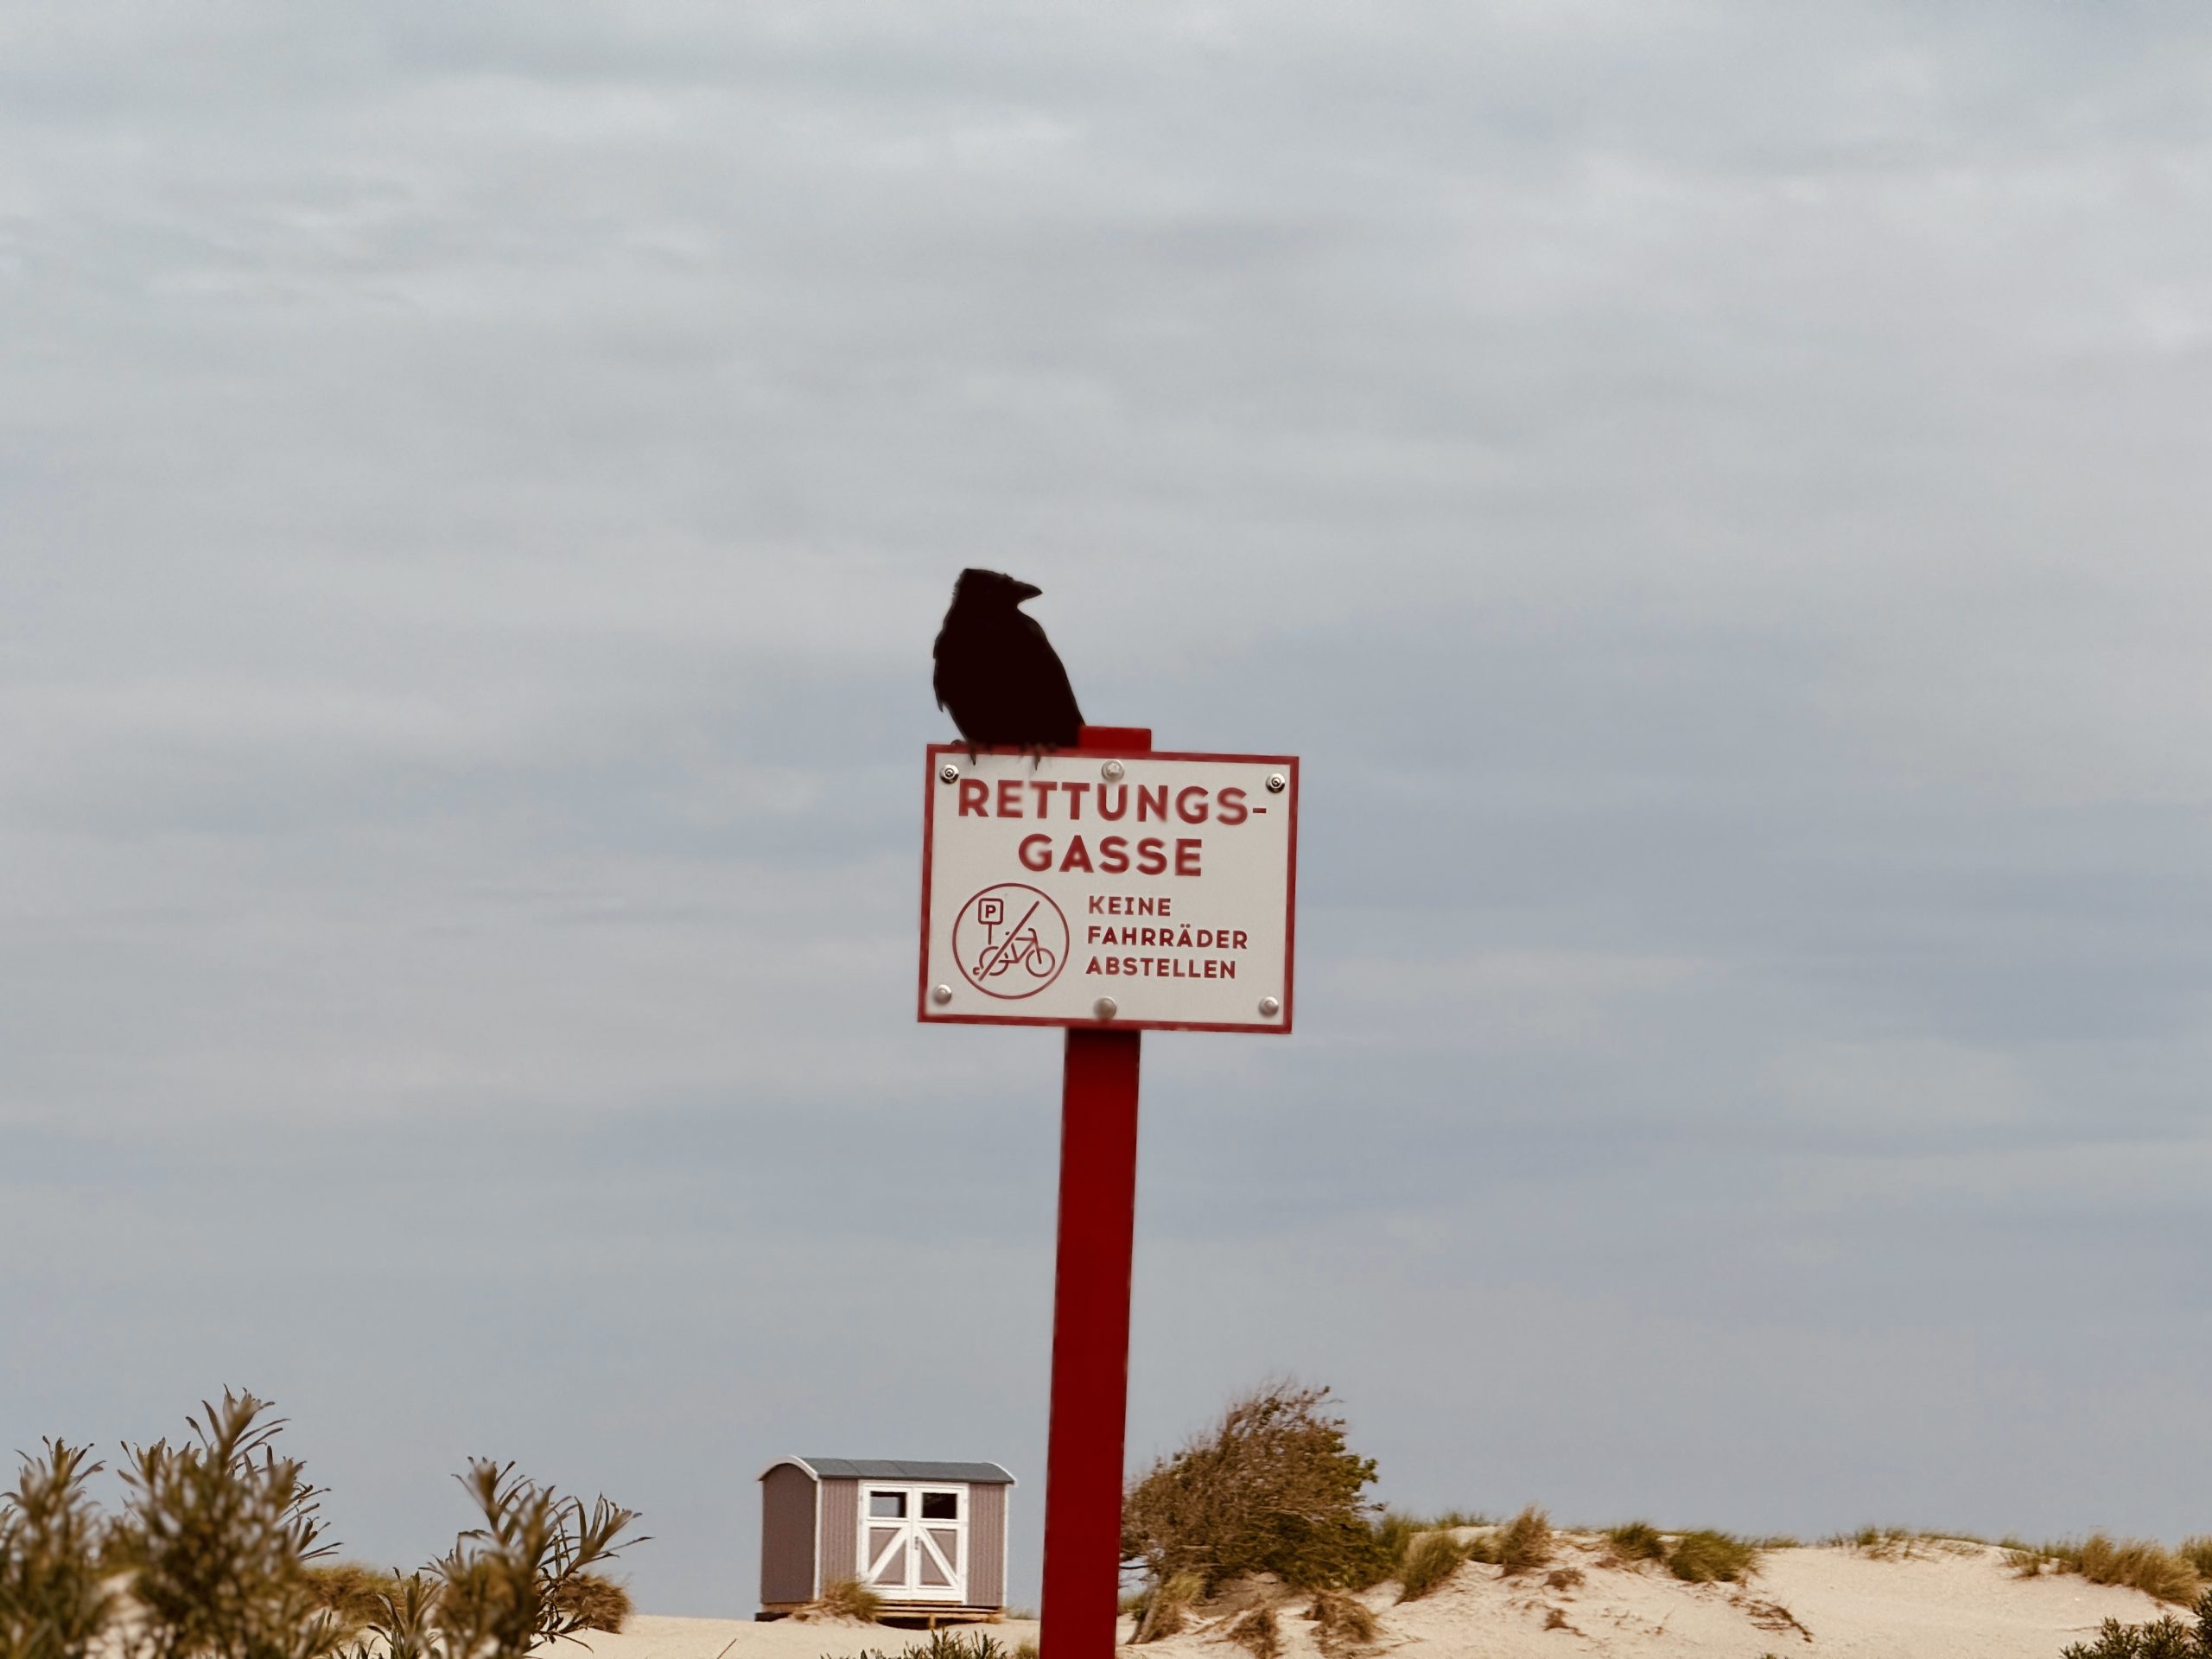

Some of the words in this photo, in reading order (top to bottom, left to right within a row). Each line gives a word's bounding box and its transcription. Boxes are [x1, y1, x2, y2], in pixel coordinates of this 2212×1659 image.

[957, 779, 1267, 825] RETTUNGS-
[1018, 833, 1202, 877] GASSE
[984, 905, 996, 918] P
[1088, 895, 1172, 917] KEINE
[1087, 924, 1249, 950] FAHRRÄDER
[1085, 956, 1236, 979] ABSTELLEN
